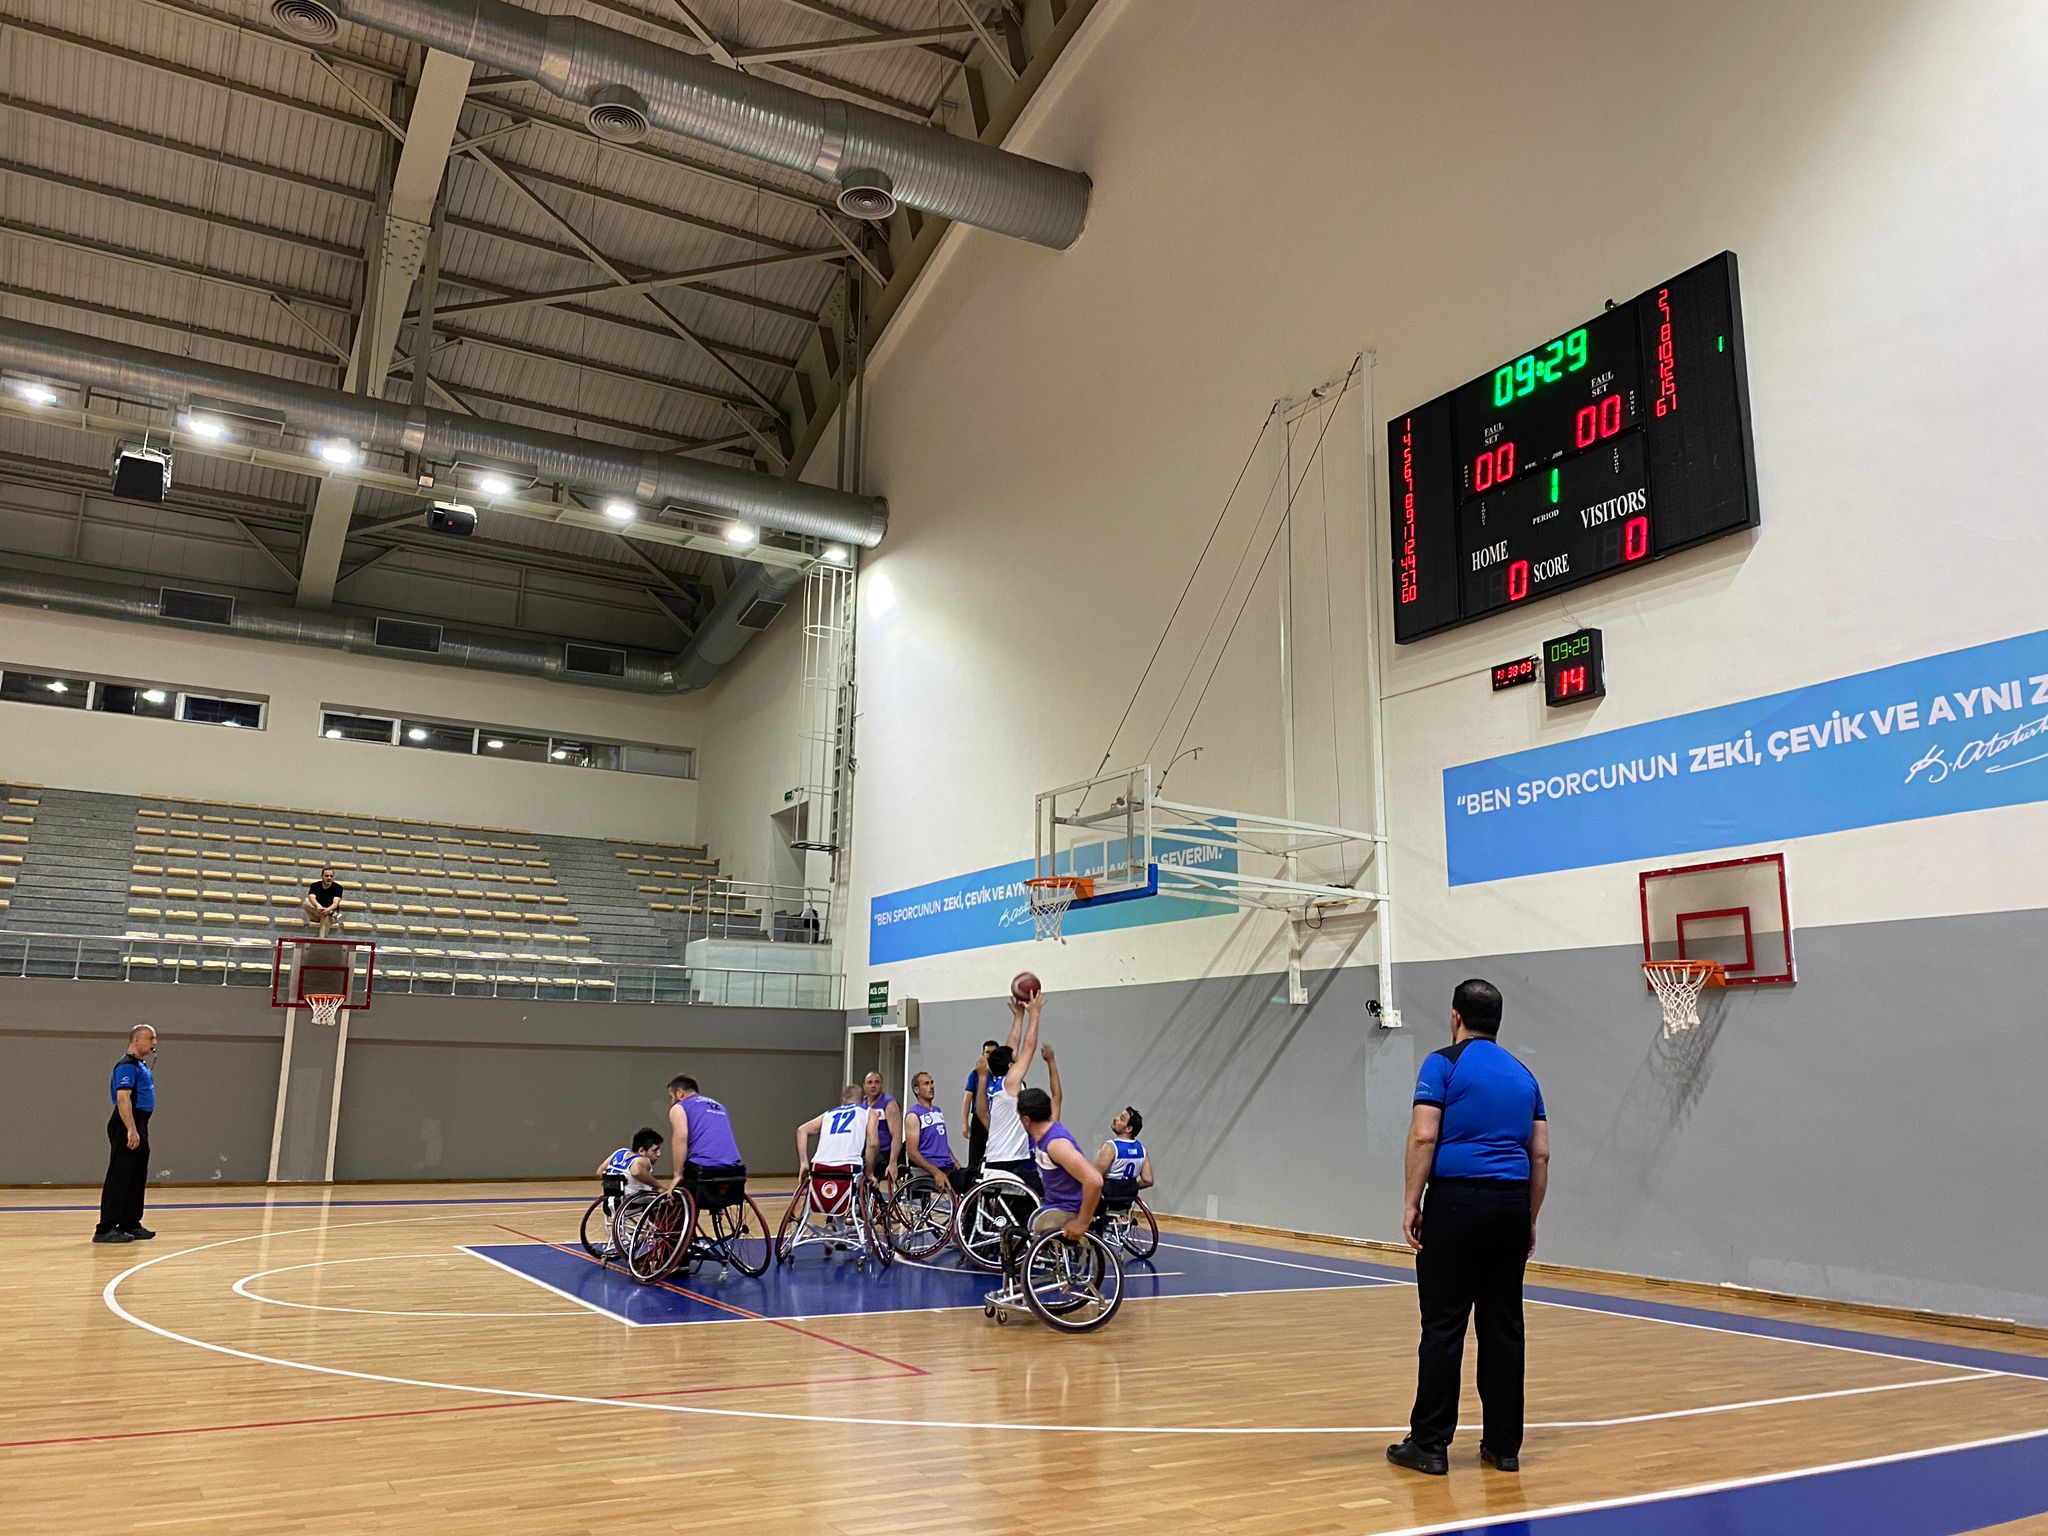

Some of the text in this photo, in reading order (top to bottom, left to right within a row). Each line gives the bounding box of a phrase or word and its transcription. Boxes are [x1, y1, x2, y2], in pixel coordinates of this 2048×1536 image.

[1658, 288, 1668, 308] 2
[1661, 323, 1671, 342] 8
[1494, 328, 1588, 407] 09:29
[1591, 371, 1614, 388] FAUL
[1591, 383, 1609, 398] SET
[1484, 422, 1504, 438] FAUL
[1576, 394, 1622, 448] 00
[1484, 434, 1500, 446] SET
[1403, 447, 1412, 464] 5
[1475, 442, 1514, 492] 00
[1404, 462, 1412, 479] 6
[1551, 468, 1559, 503] 1
[1405, 493, 1413, 509] 8
[1580, 488, 1647, 529] VISITORS
[1406, 508, 1414, 525] 9
[1532, 509, 1560, 526] PERIOD
[1625, 516, 1648, 561] 0
[1471, 540, 1509, 571] HOME
[1533, 553, 1570, 583] SCORE
[1508, 560, 1528, 601] 0
[1402, 584, 1417, 604] 60
[1551, 636, 1590, 662] 09:29
[1559, 666, 1586, 697] 14
[1516, 752, 1678, 806] SPORCUNUN
[1688, 730, 1763, 773] ZEKİ,
[1767, 710, 1868, 763] ÇEVİK
[1870, 702, 1920, 736] VE
[1928, 680, 2023, 726] AYNI
[893, 899, 941, 923] SPORCUNUN
[943, 890, 964, 912] ZEKİ,
[964, 885, 991, 910] ÇEVİK
[991, 886, 1005, 901] VE
[829, 1109, 856, 1135] 12
